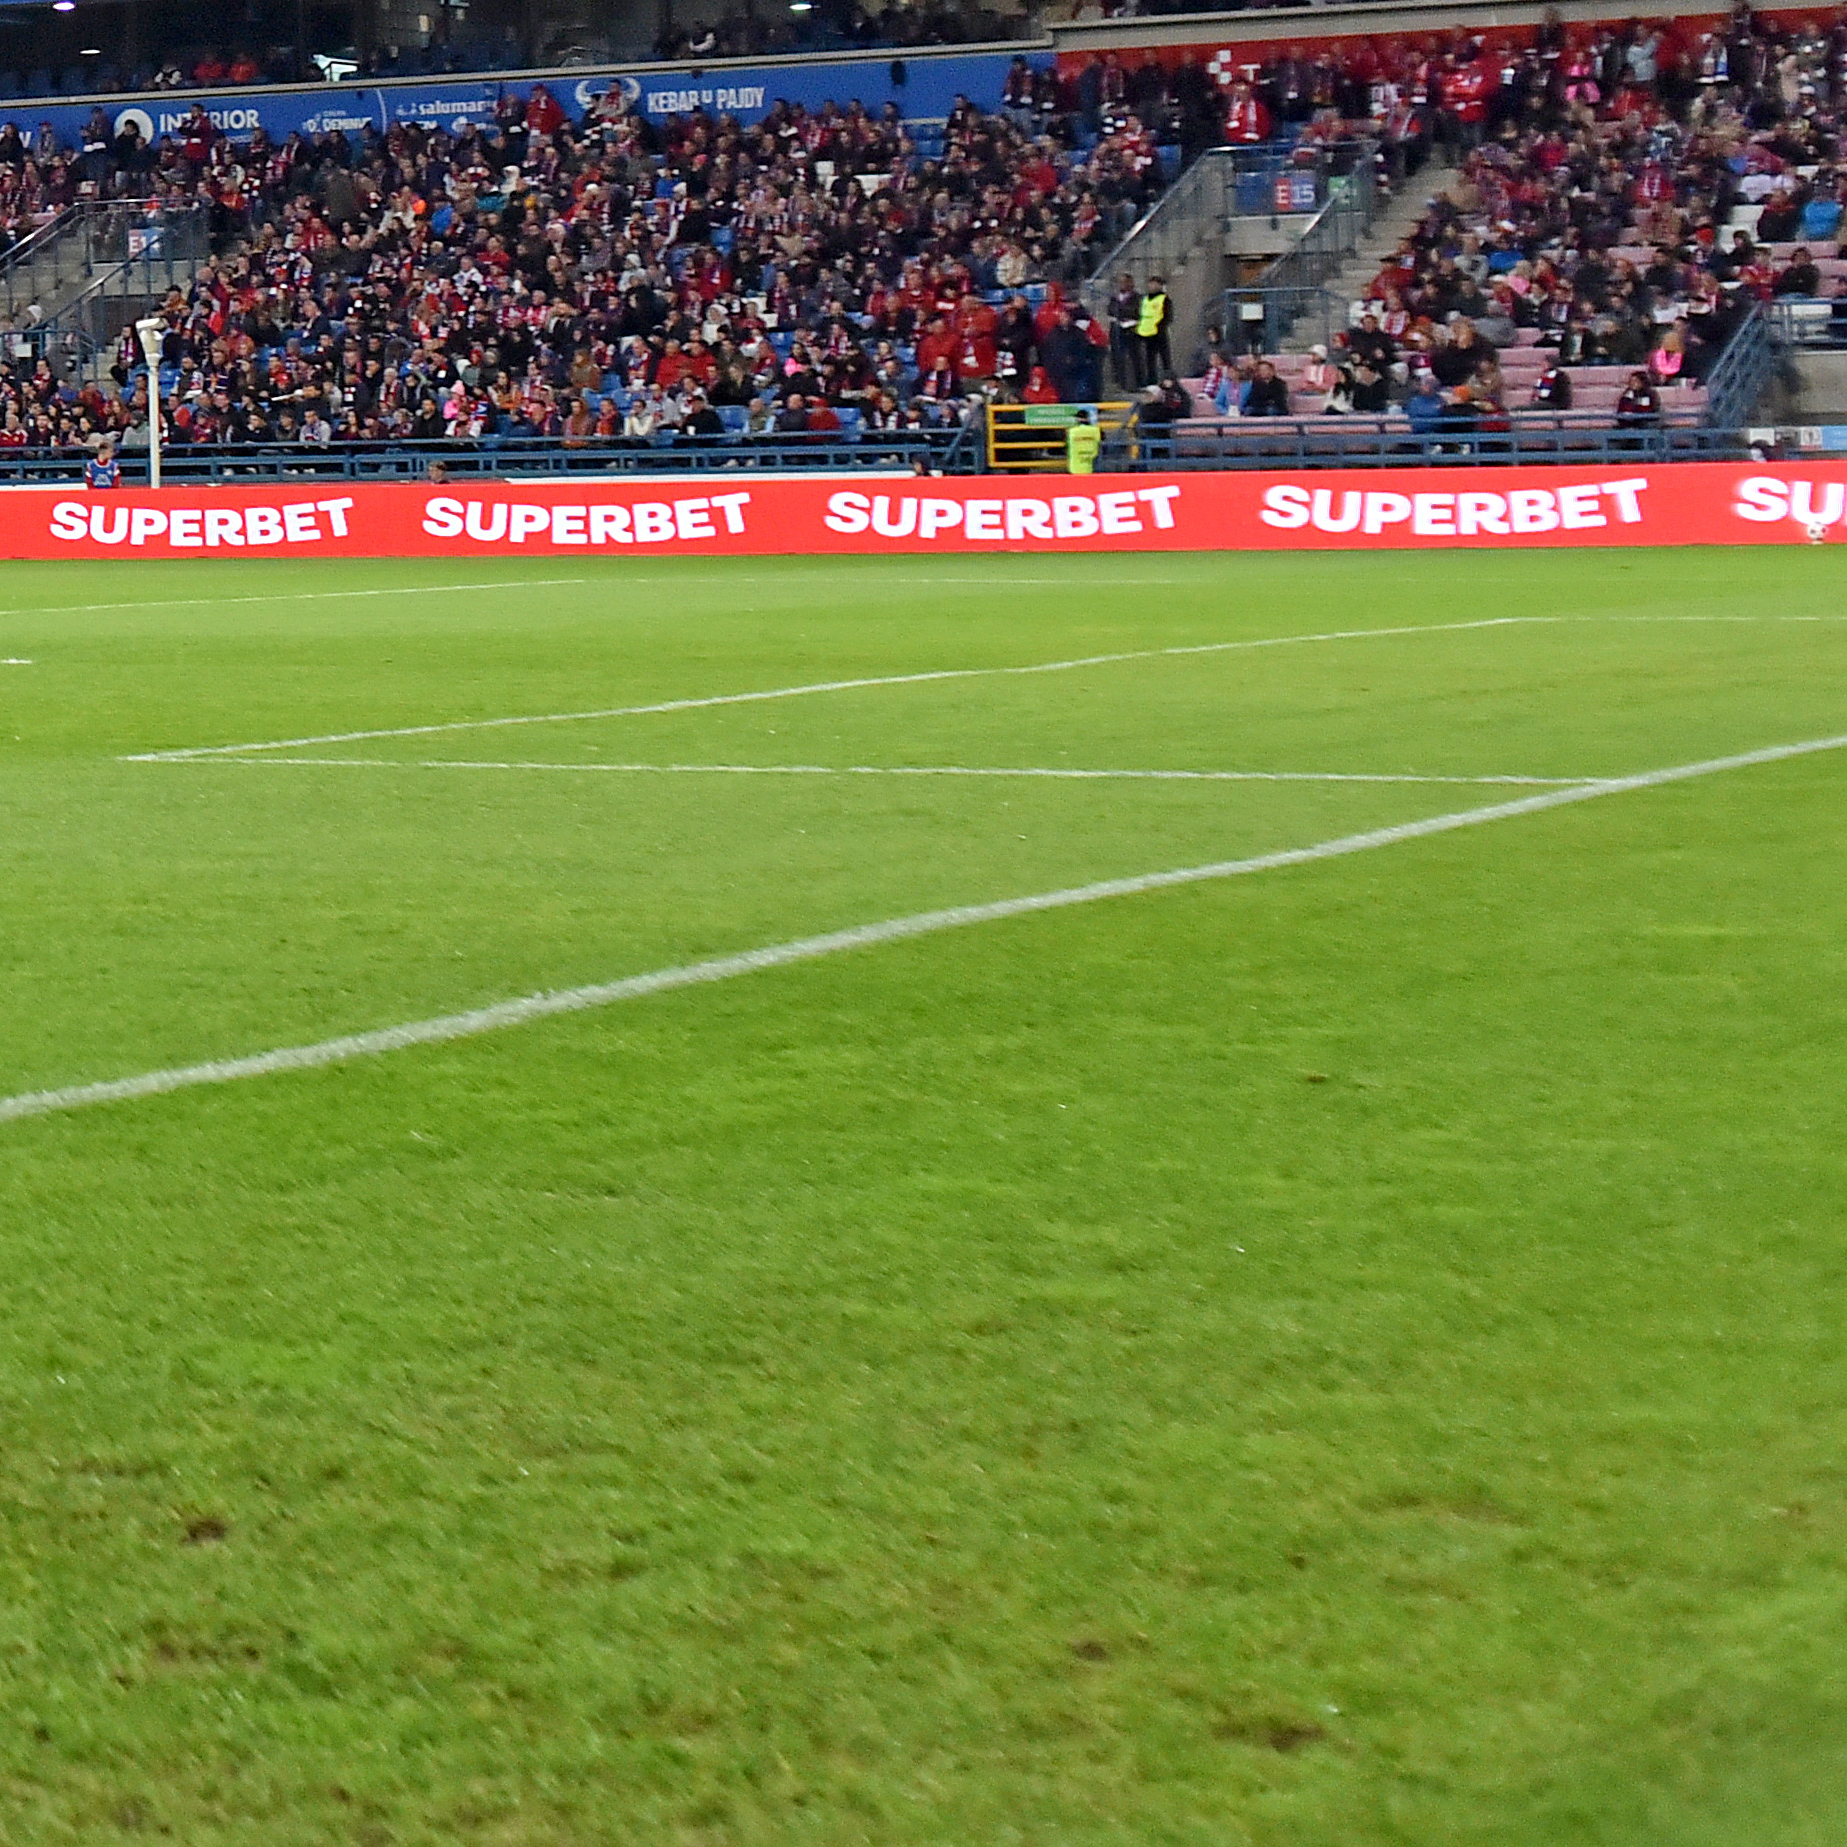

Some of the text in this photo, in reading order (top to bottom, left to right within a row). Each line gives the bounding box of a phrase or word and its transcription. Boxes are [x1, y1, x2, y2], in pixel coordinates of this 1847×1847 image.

[50, 498, 354, 547] SUPERBET
[423, 493, 751, 545] SUPERBET
[824, 486, 1181, 540] SUPERBET
[1260, 479, 1648, 536] SUPERBET
